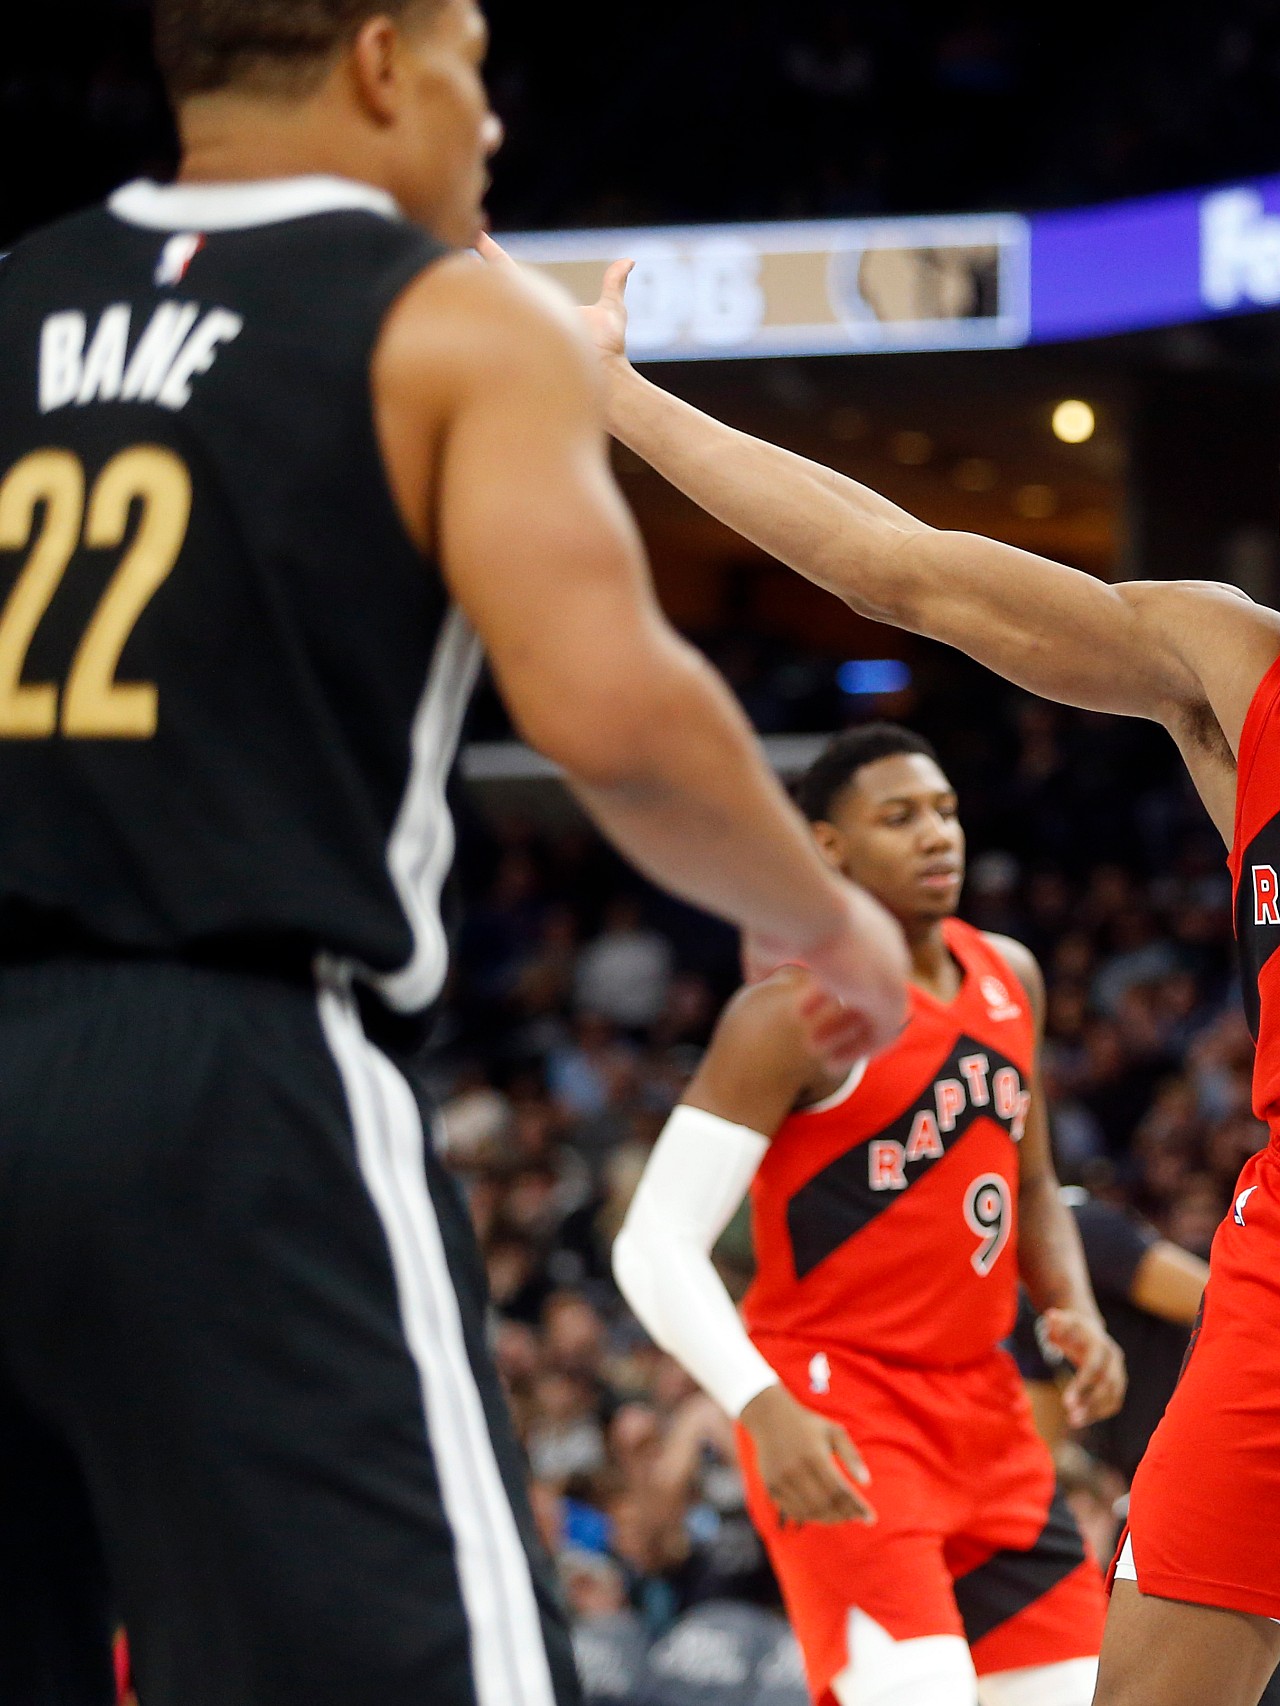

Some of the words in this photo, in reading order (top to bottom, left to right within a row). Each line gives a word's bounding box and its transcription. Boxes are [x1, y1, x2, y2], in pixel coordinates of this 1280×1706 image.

[39, 302, 244, 413] BANE
[0, 443, 193, 740] 22
[963, 1172, 1012, 1278] 9
